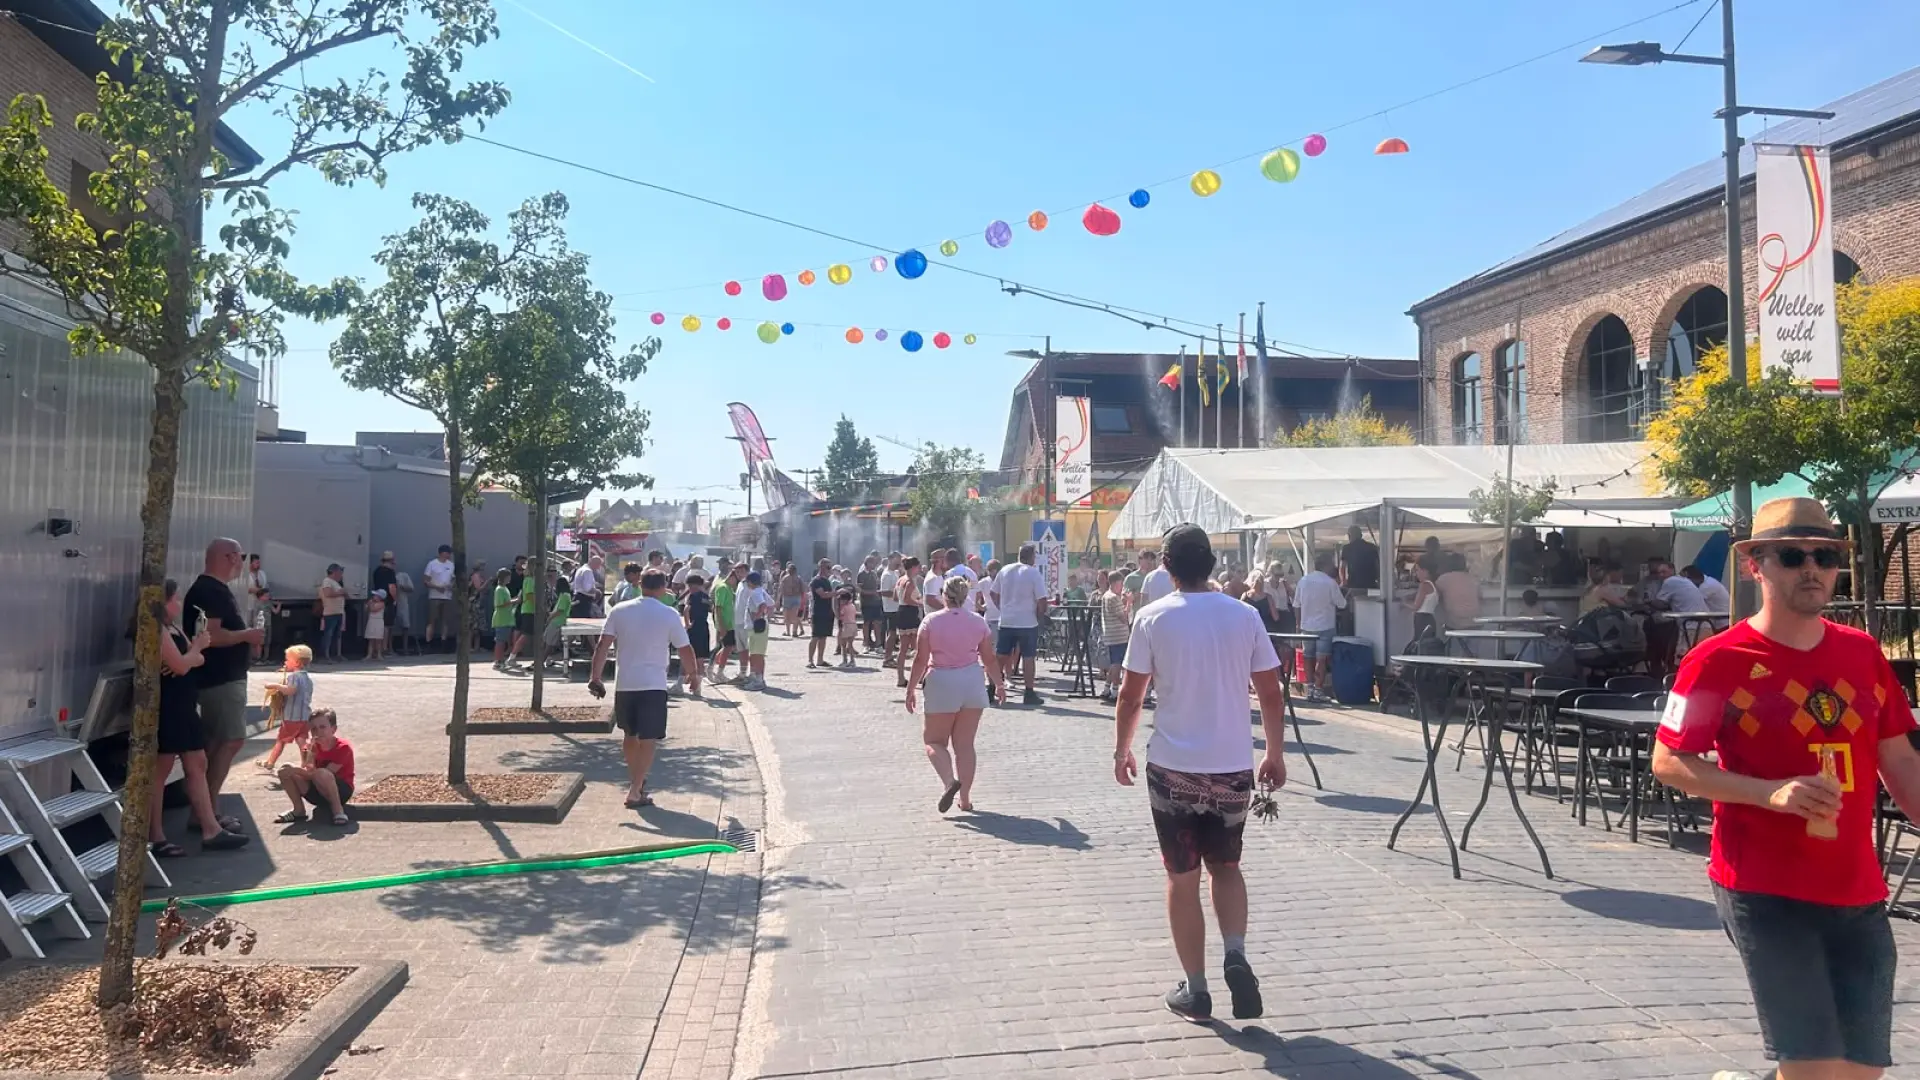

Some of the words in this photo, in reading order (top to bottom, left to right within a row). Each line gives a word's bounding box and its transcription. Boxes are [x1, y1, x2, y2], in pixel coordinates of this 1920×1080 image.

[1768, 293, 1825, 317] Wellen
[1777, 320, 1815, 341] wild
[1780, 348, 1813, 363] van
